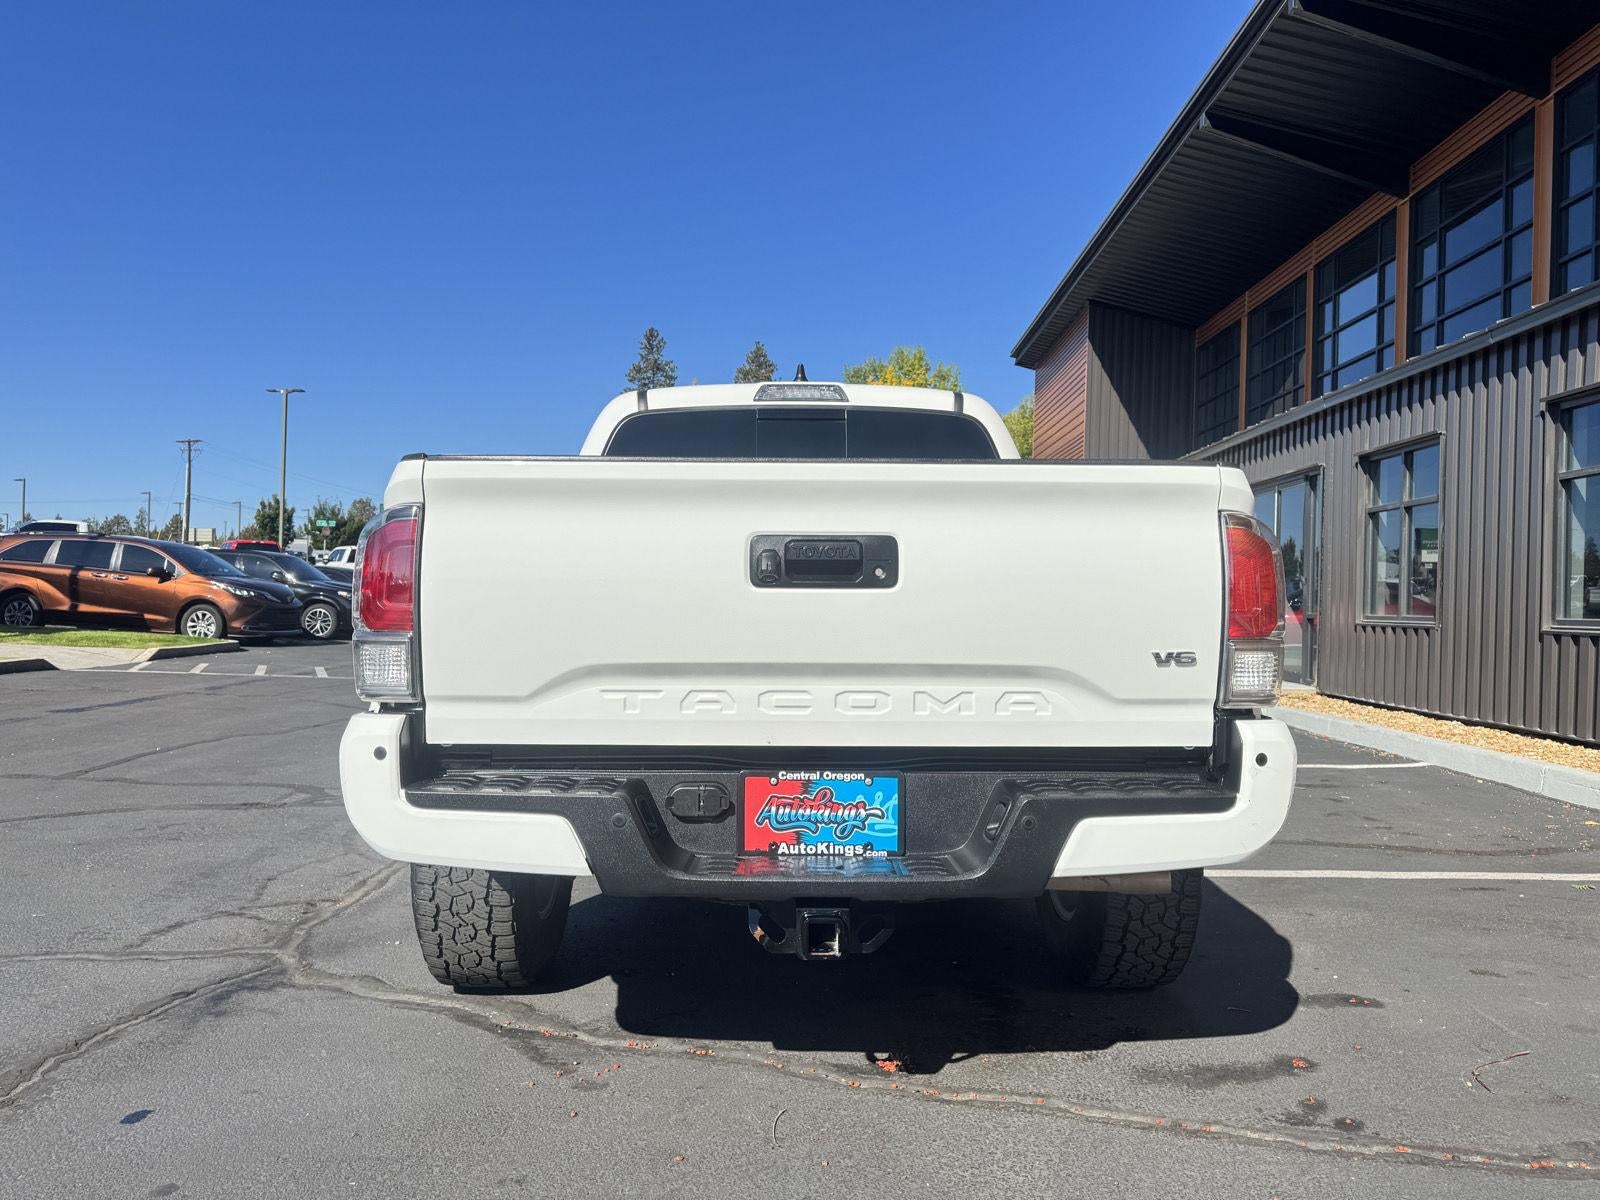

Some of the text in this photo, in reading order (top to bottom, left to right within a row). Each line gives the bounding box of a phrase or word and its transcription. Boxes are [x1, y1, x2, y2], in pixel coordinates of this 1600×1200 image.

[793, 545, 857, 558] TOYOTA
[1151, 651, 1197, 668] V6
[600, 689, 1052, 716] TACOMA
[778, 771, 865, 782] Central Oregon
